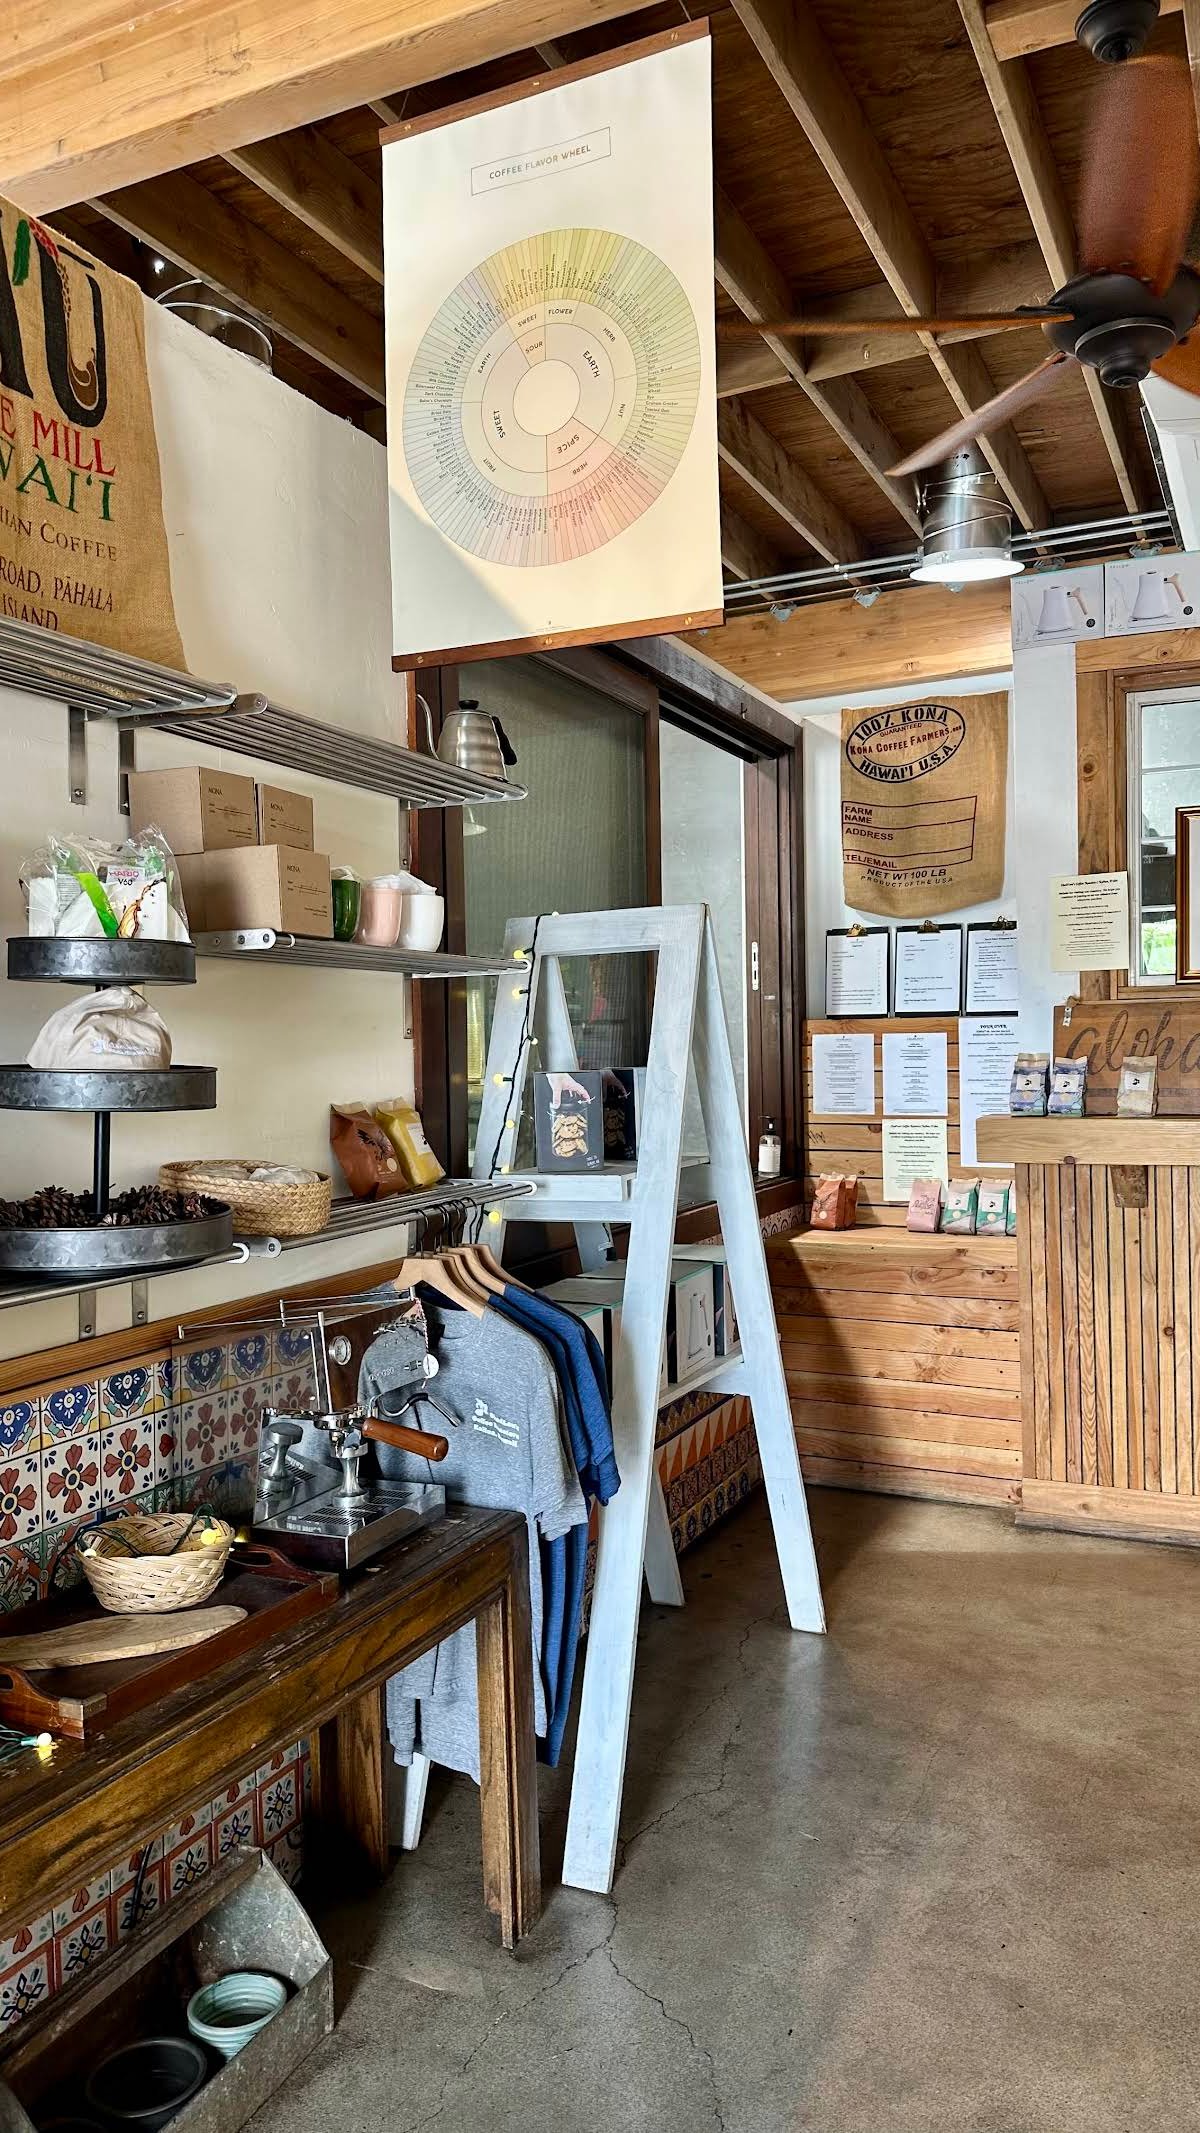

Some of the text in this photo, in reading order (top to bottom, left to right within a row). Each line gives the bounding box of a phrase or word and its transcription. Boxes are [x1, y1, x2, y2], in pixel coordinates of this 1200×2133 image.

[489, 144, 591, 179] COFFEE FLAVOR WHEEL
[517, 314, 537, 328] SWEET
[602, 327, 616, 342] HERB
[525, 341, 543, 354] SOUR
[478, 352, 492, 373] EARTH
[582, 350, 600, 378] EARTH
[617, 403, 625, 418] NUT
[493, 410, 506, 439] SWEET
[32, 410, 117, 477] MILL
[556, 434, 579, 454] SPICE
[483, 457, 496, 473] FRUIT
[572, 462, 588, 475] HERB
[40, 522, 117, 562] COFFEE
[0, 556, 44, 598] ROAD,
[855, 707, 948, 741] 100% KONA
[879, 723, 922, 737] GUARANTEED
[850, 745, 873, 755] KONA
[876, 740, 908, 753] COFFEE
[859, 744, 957, 780] HAWAI'I U.S.A.
[845, 806, 873, 816] FARM
[844, 814, 872, 824] NAME
[845, 827, 894, 841] ADDRESS
[846, 854, 897, 869] TEL/EMAIL
[860, 875, 902, 888] PRODUCT
[867, 868, 947, 880] NET WT 100 LB
[117, 878, 133, 886] V60
